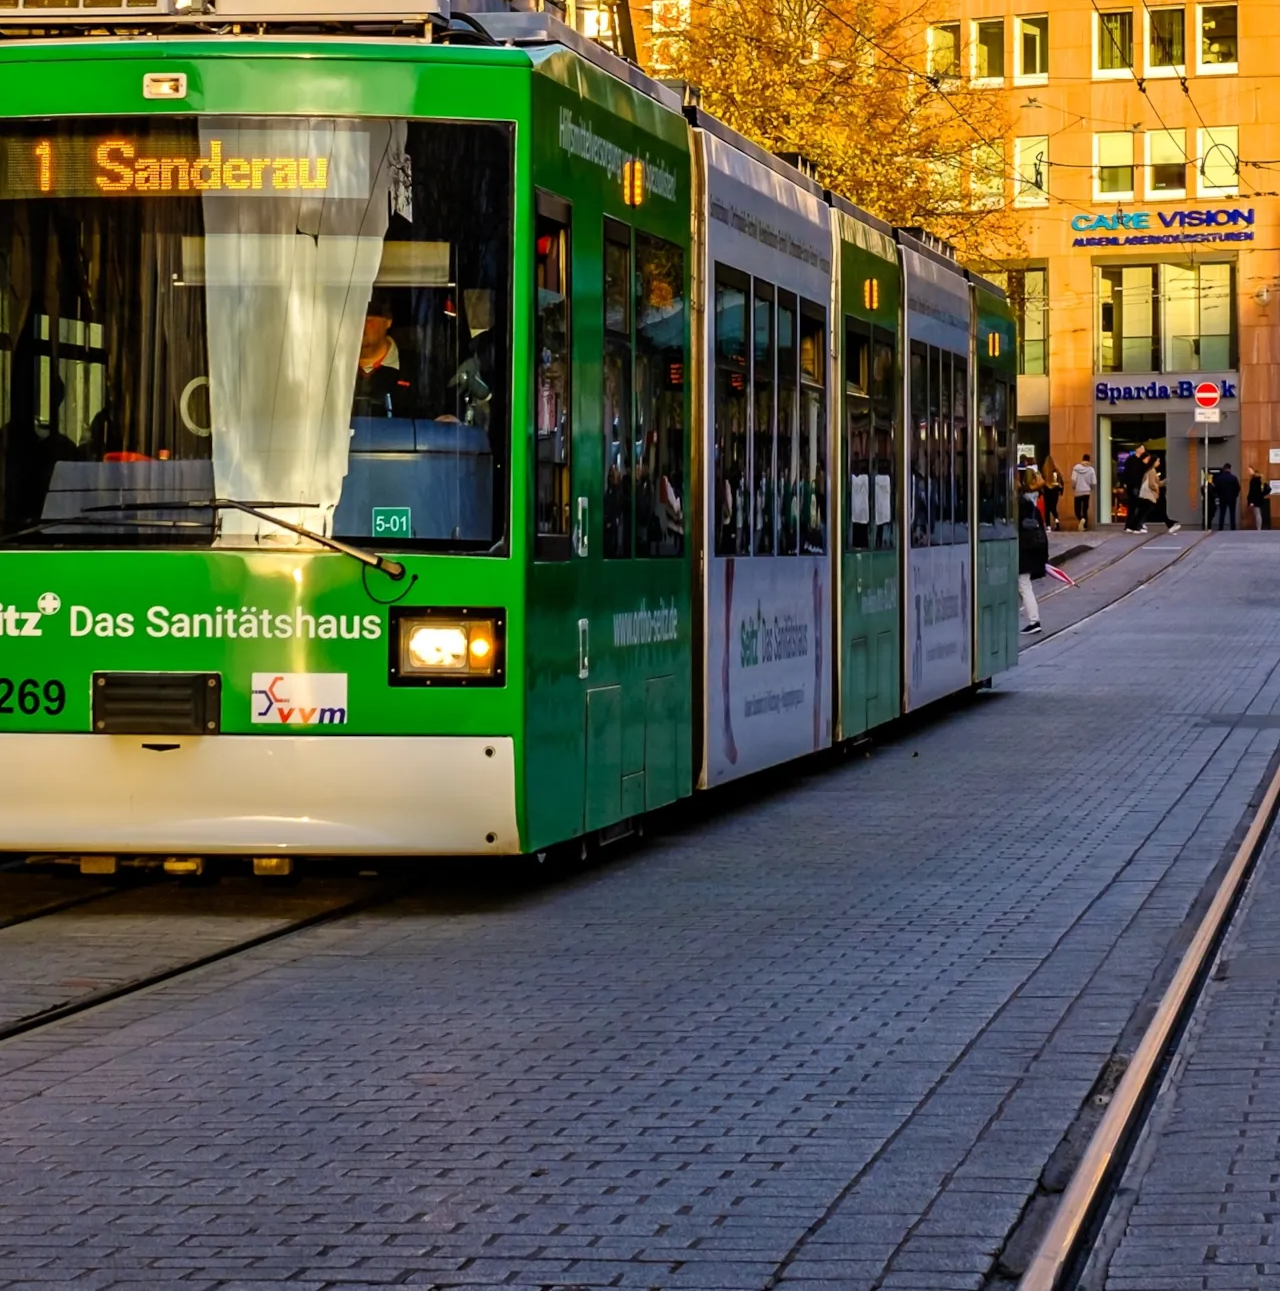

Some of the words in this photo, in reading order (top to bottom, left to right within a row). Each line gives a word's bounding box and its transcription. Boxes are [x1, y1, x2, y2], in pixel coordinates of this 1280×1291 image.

[35, 140, 51, 191] 1
[96, 140, 327, 191] Sanderau
[1071, 212, 1151, 232] CARE
[1157, 208, 1254, 228] VISION
[1095, 380, 1236, 405] Sparda-Bk
[376, 515, 407, 532] 5-01
[70, 606, 135, 637] Das
[146, 605, 382, 639] Sanitätshaus
[613, 596, 677, 646] www.ortho-seitz.de
[277, 707, 346, 724] vvm
